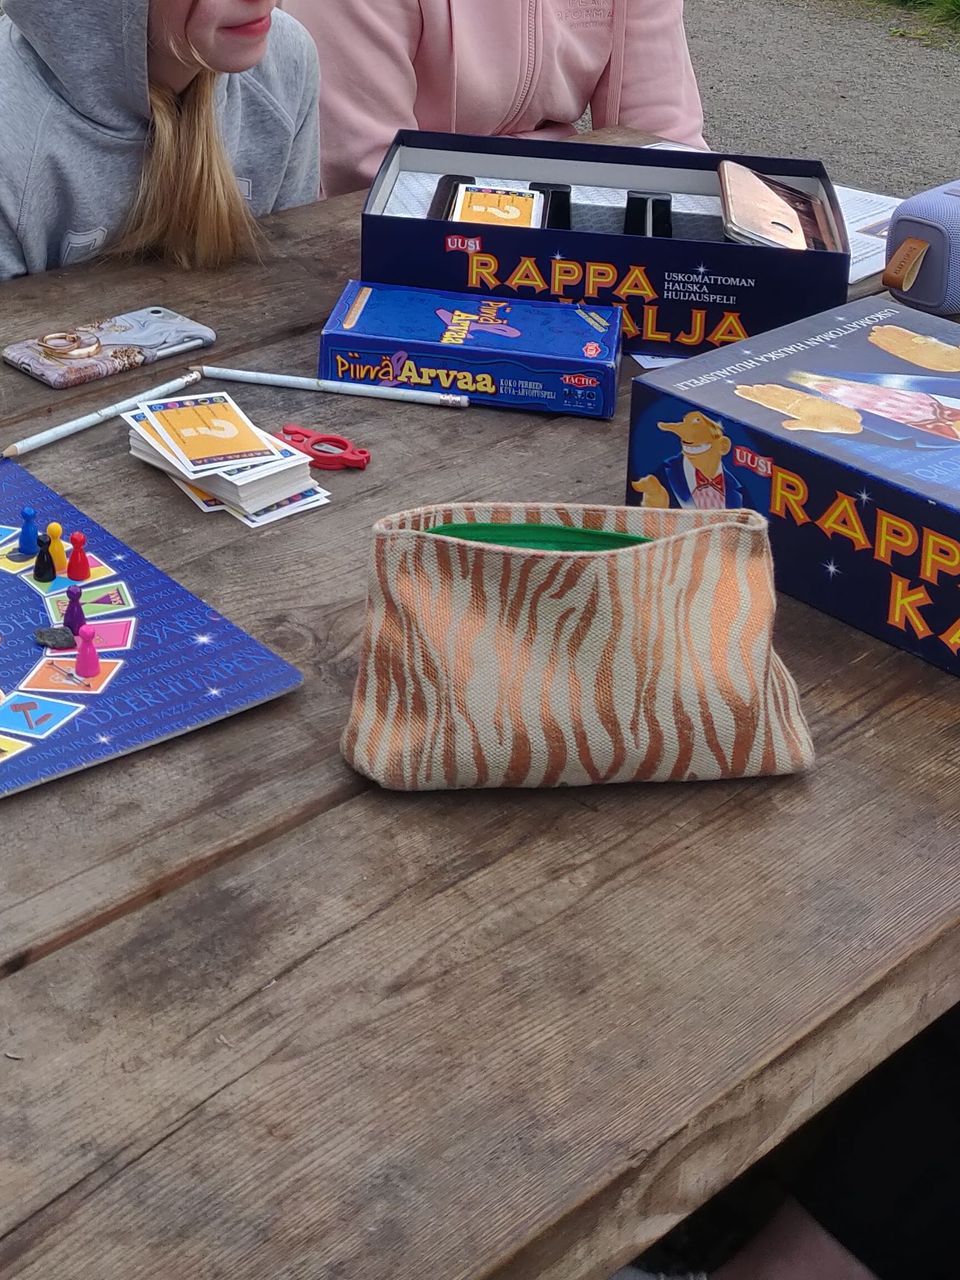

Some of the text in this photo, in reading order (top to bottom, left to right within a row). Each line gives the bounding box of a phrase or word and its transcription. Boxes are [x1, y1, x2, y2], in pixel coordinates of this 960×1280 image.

[447, 237, 481, 252] UUSI
[468, 251, 659, 303] RAPPA
[664, 272, 755, 288] USKOMATTOMAN
[664, 282, 709, 294] HAUSKA
[663, 291, 737, 306] HUIJAUSPELI!
[613, 302, 750, 347] ALJA
[805, 307, 901, 350] USKOMATTOMAN
[757, 339, 806, 365] HAUSKA
[397, 359, 497, 395] Arvaa
[563, 374, 597, 387] TACTIC
[735, 448, 773, 475] UUSI
[769, 464, 960, 586] RAPP
[62, 649, 280, 732] ADLERHUMPEN
